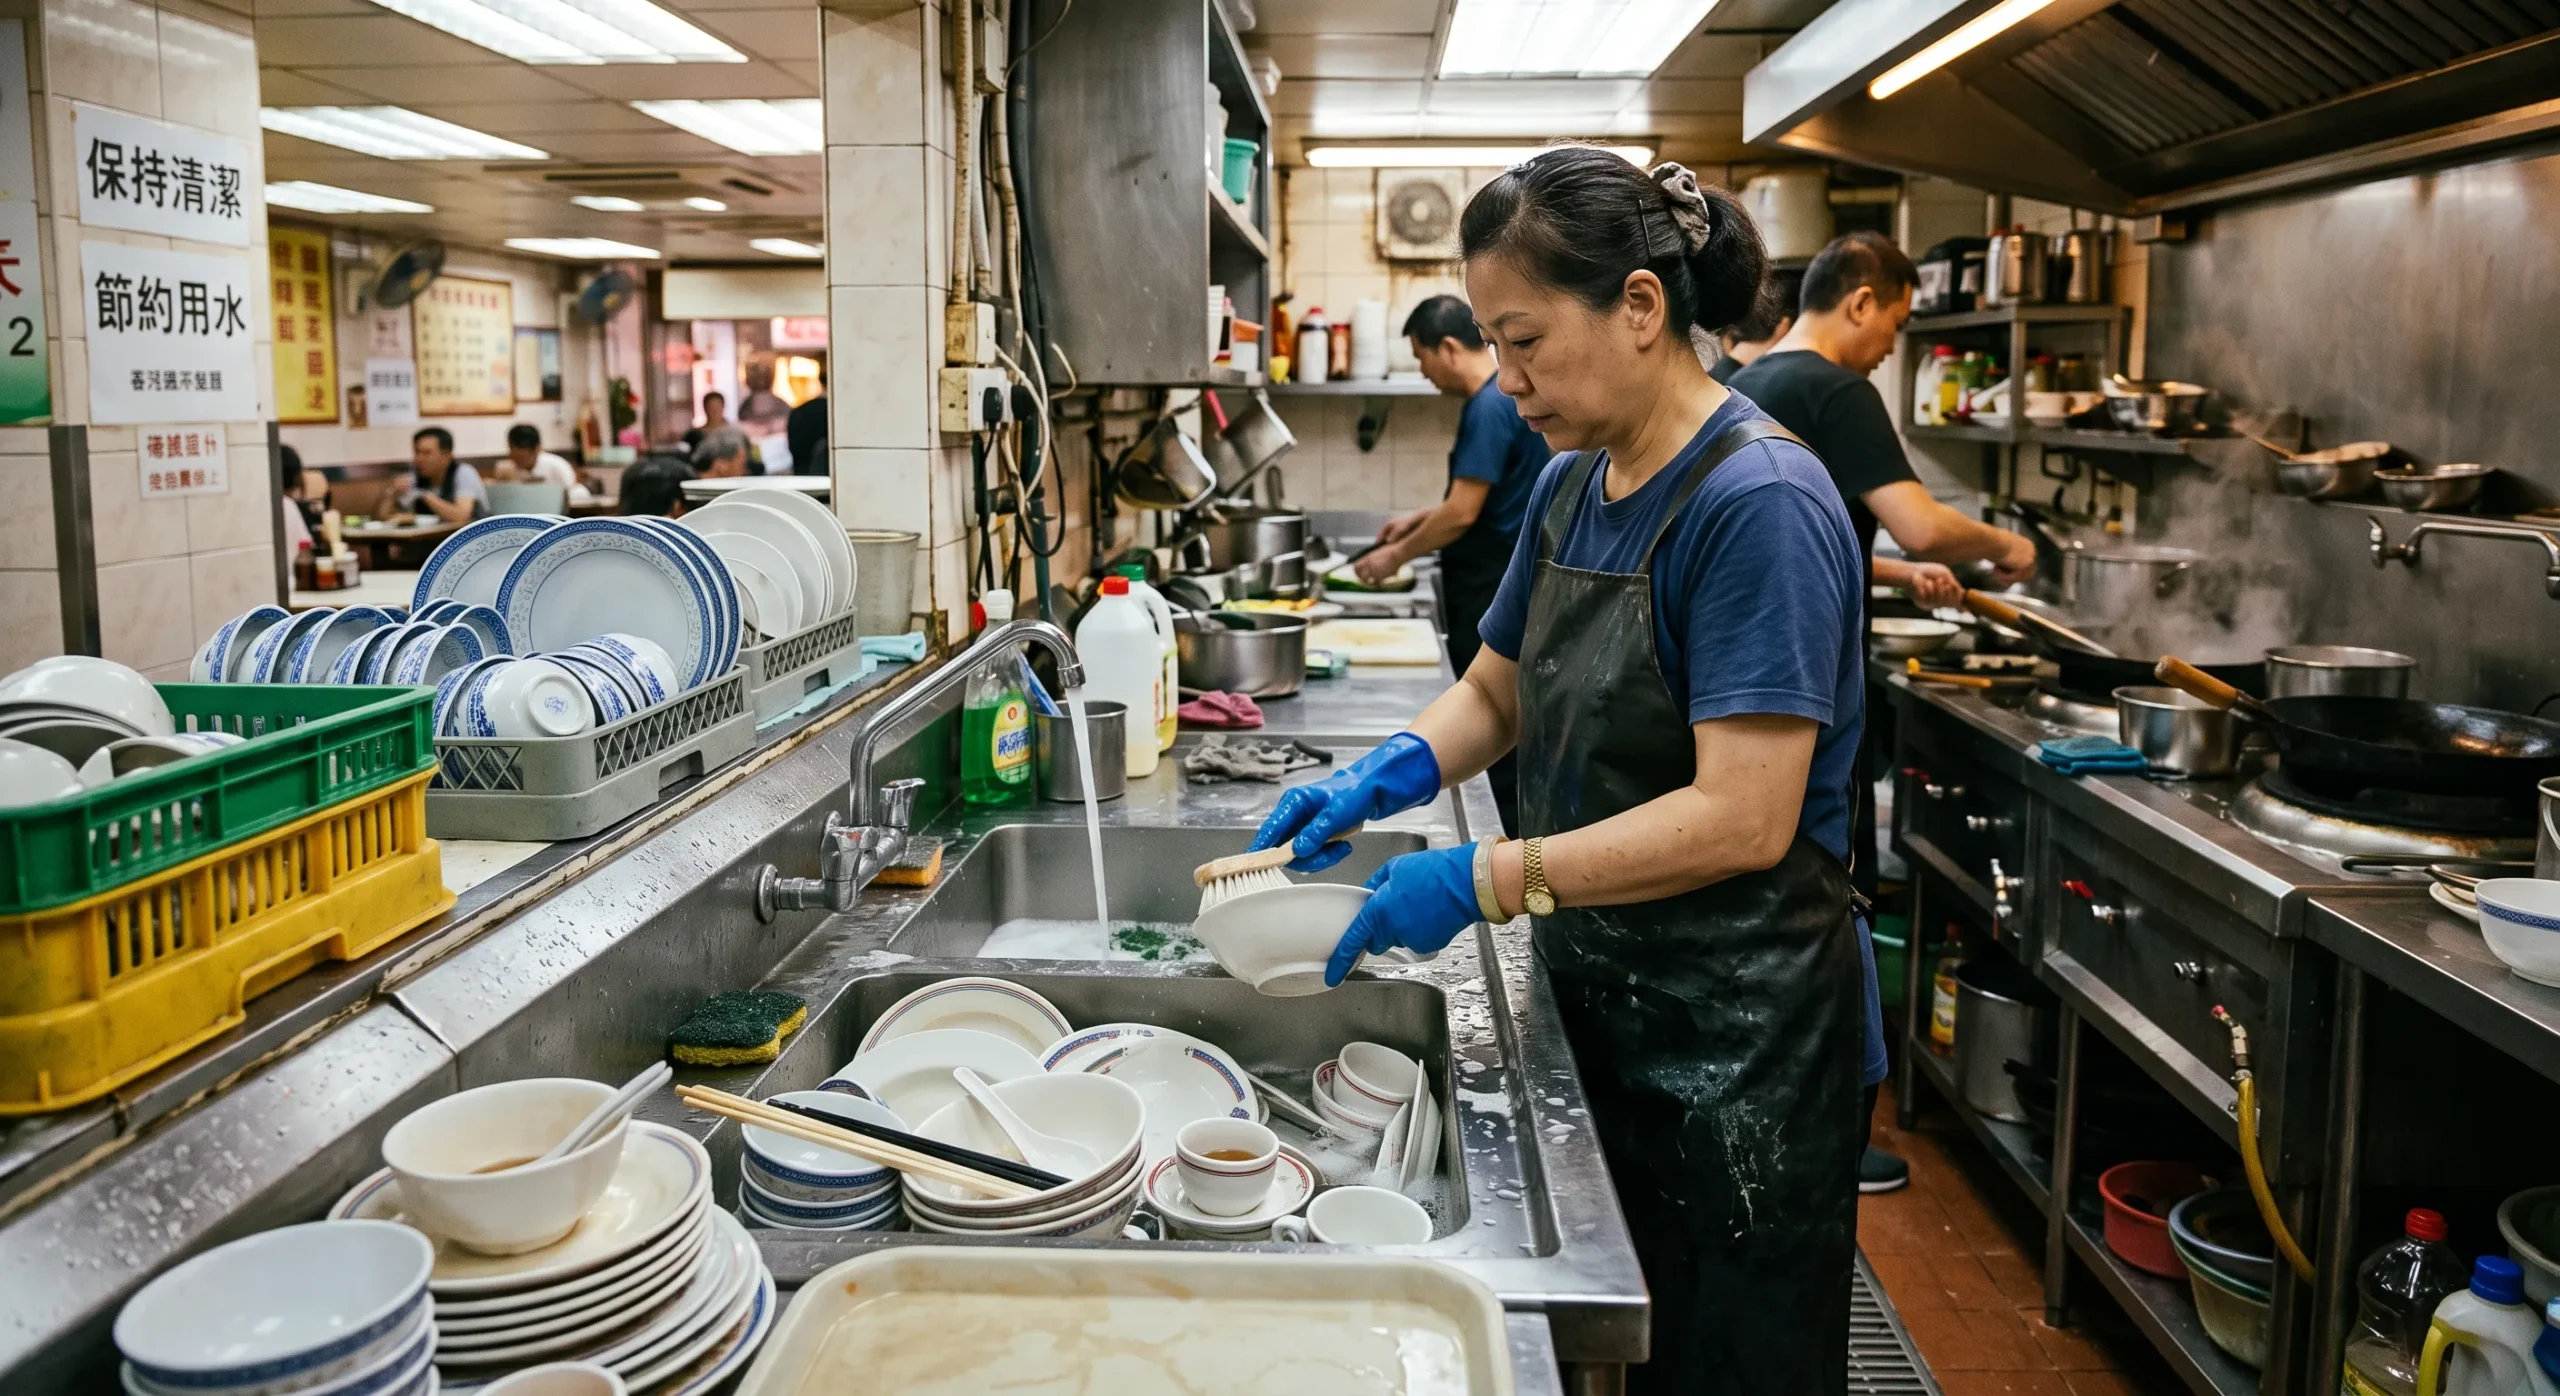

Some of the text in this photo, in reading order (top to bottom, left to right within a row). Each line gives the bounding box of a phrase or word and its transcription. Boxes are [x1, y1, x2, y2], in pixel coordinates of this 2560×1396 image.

[86, 137, 242, 218] 保持清潔
[8, 315, 36, 356] 2
[95, 270, 246, 337] 節約用水
